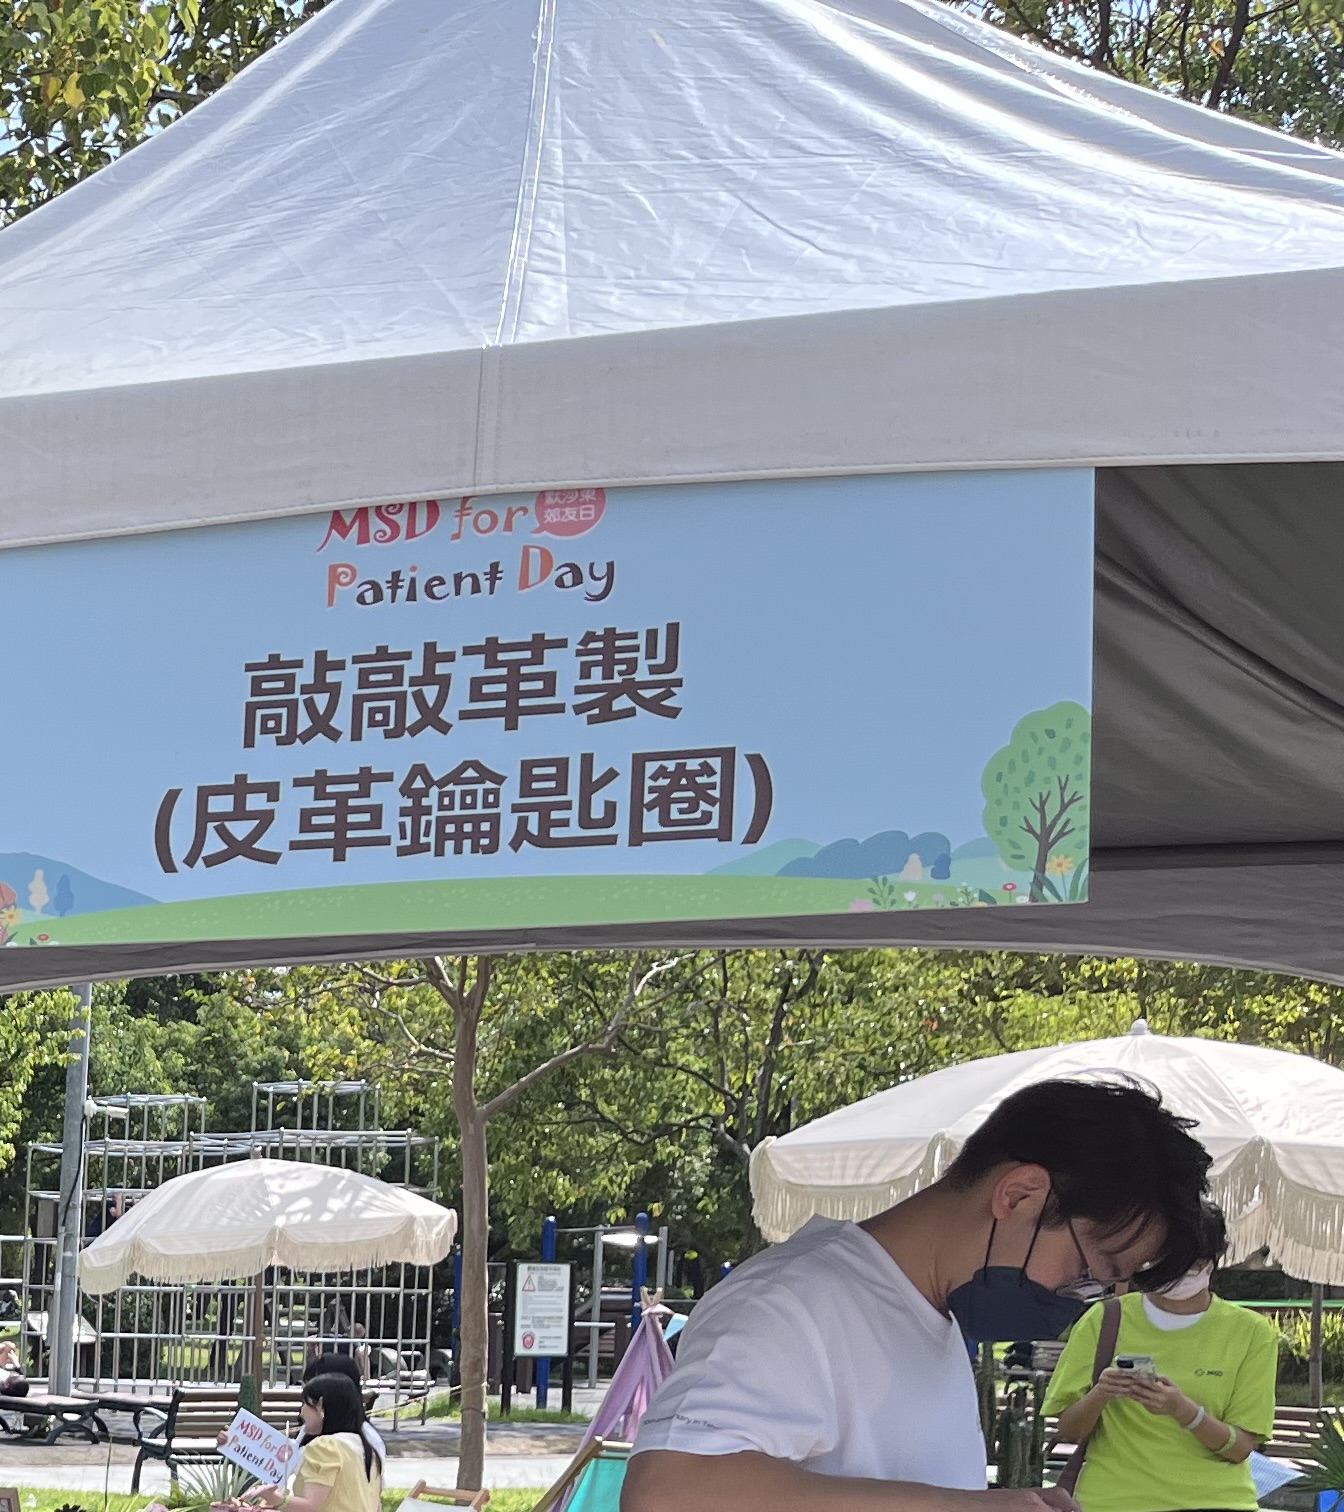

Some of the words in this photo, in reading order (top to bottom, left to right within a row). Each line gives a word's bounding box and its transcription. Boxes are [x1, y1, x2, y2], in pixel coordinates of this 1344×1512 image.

[316, 500, 440, 552] MSD
[451, 496, 529, 541] for
[328, 563, 503, 608] Patient
[518, 544, 615, 602] Day
[243, 620, 683, 749] 敲敲革製
[154, 746, 774, 874] (皮革鑰匙圈)
[227, 1434, 265, 1468] Patient
[264, 1457, 284, 1485] Day
[236, 1419, 264, 1441] MSD
[259, 1434, 278, 1453] for
